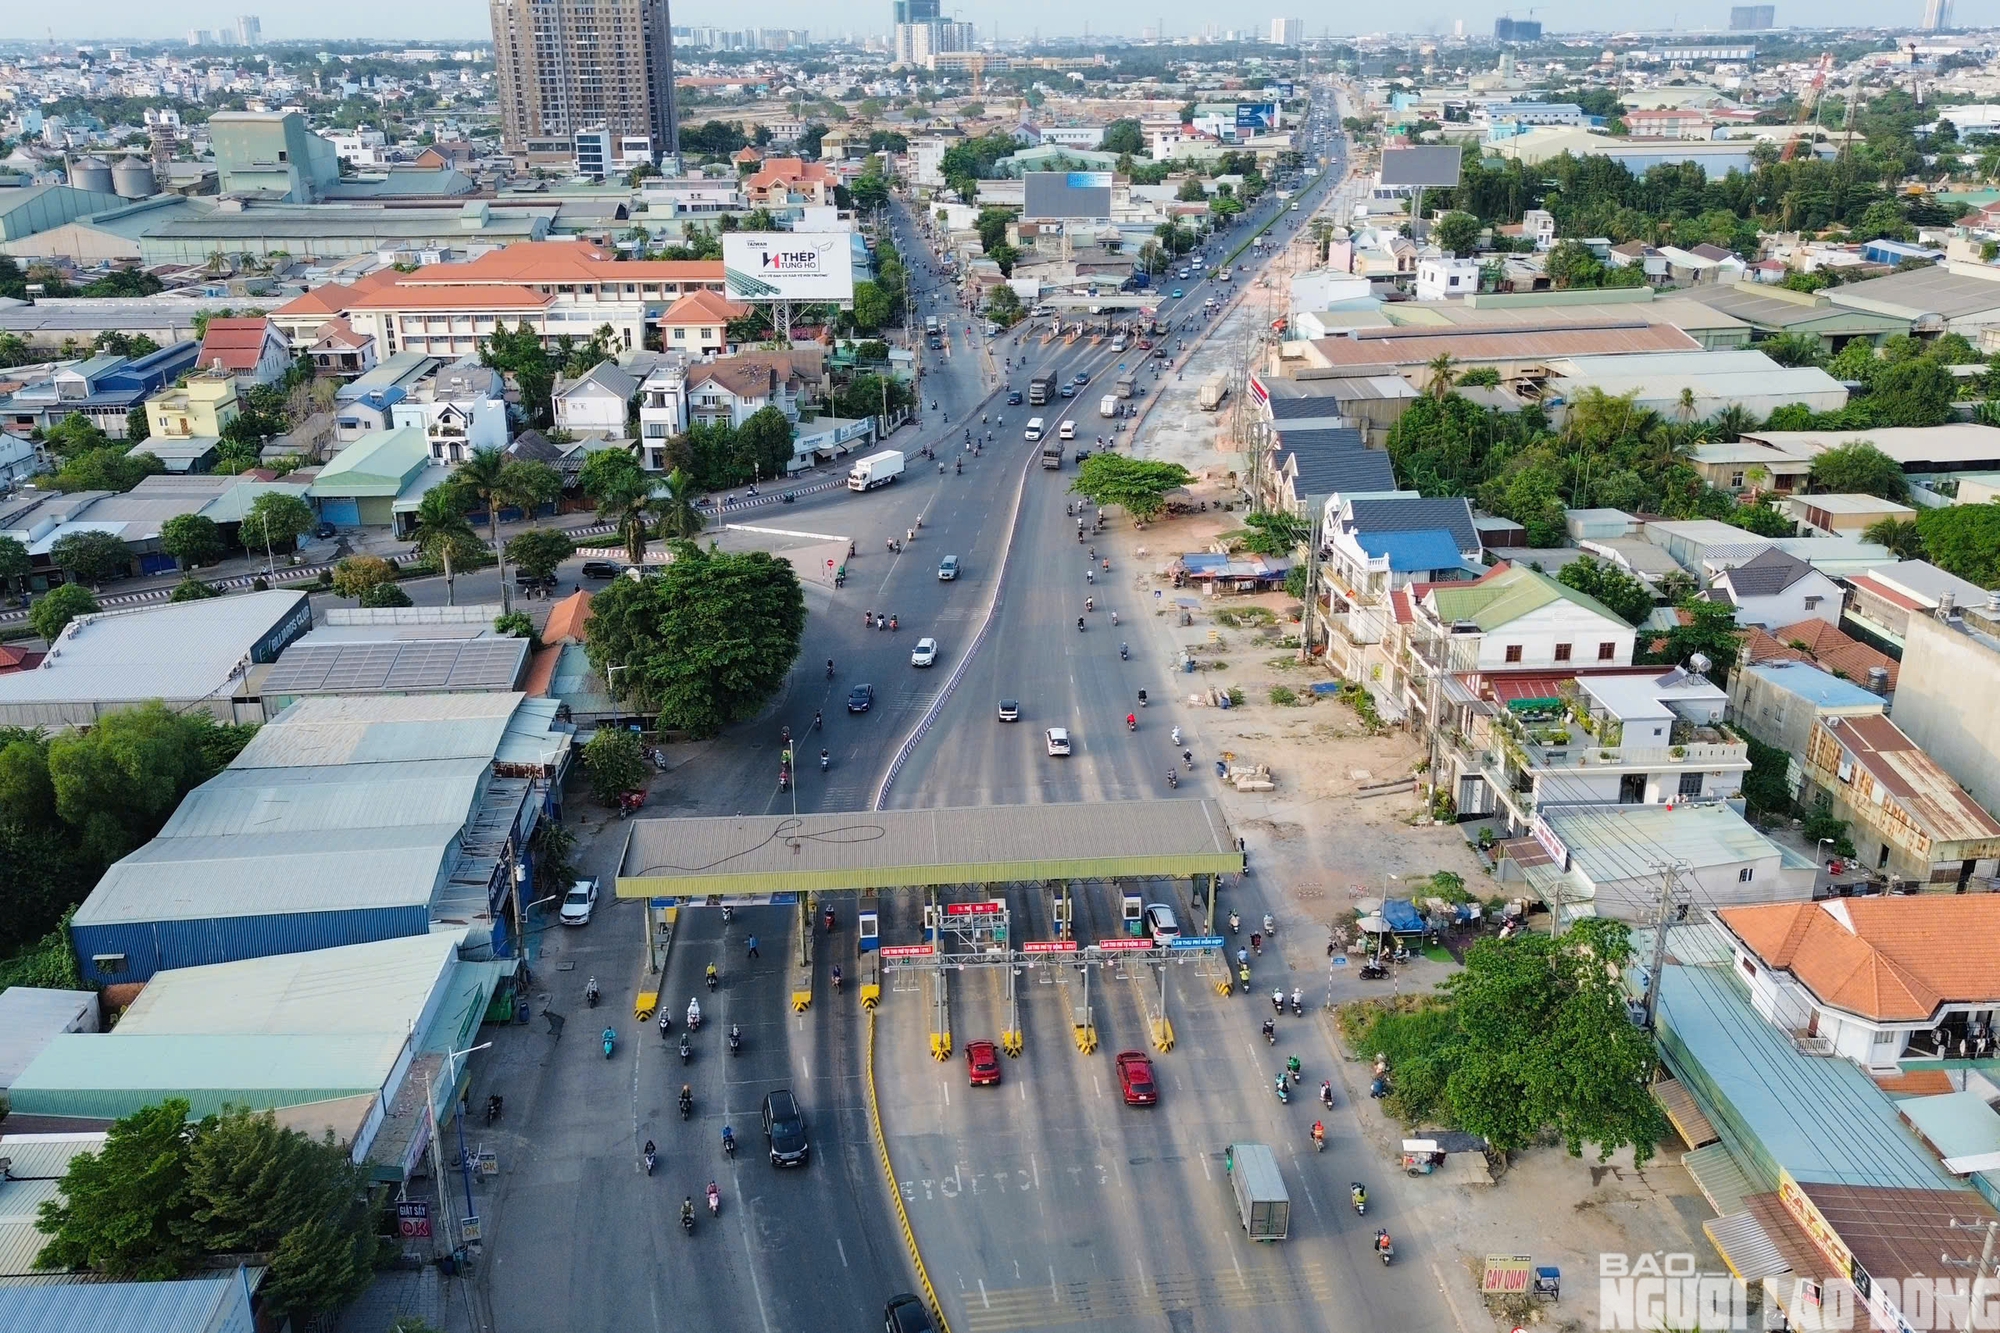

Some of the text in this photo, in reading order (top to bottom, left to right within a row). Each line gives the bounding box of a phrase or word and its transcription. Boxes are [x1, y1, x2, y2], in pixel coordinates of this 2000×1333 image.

[781, 250, 815, 261] THÉP
[296, 605, 310, 626] CLUB
[482, 1162, 496, 1171] OK
[402, 1220, 428, 1236] OK
[464, 1226, 479, 1236] OK
[1504, 1269, 1528, 1290] QUAY
